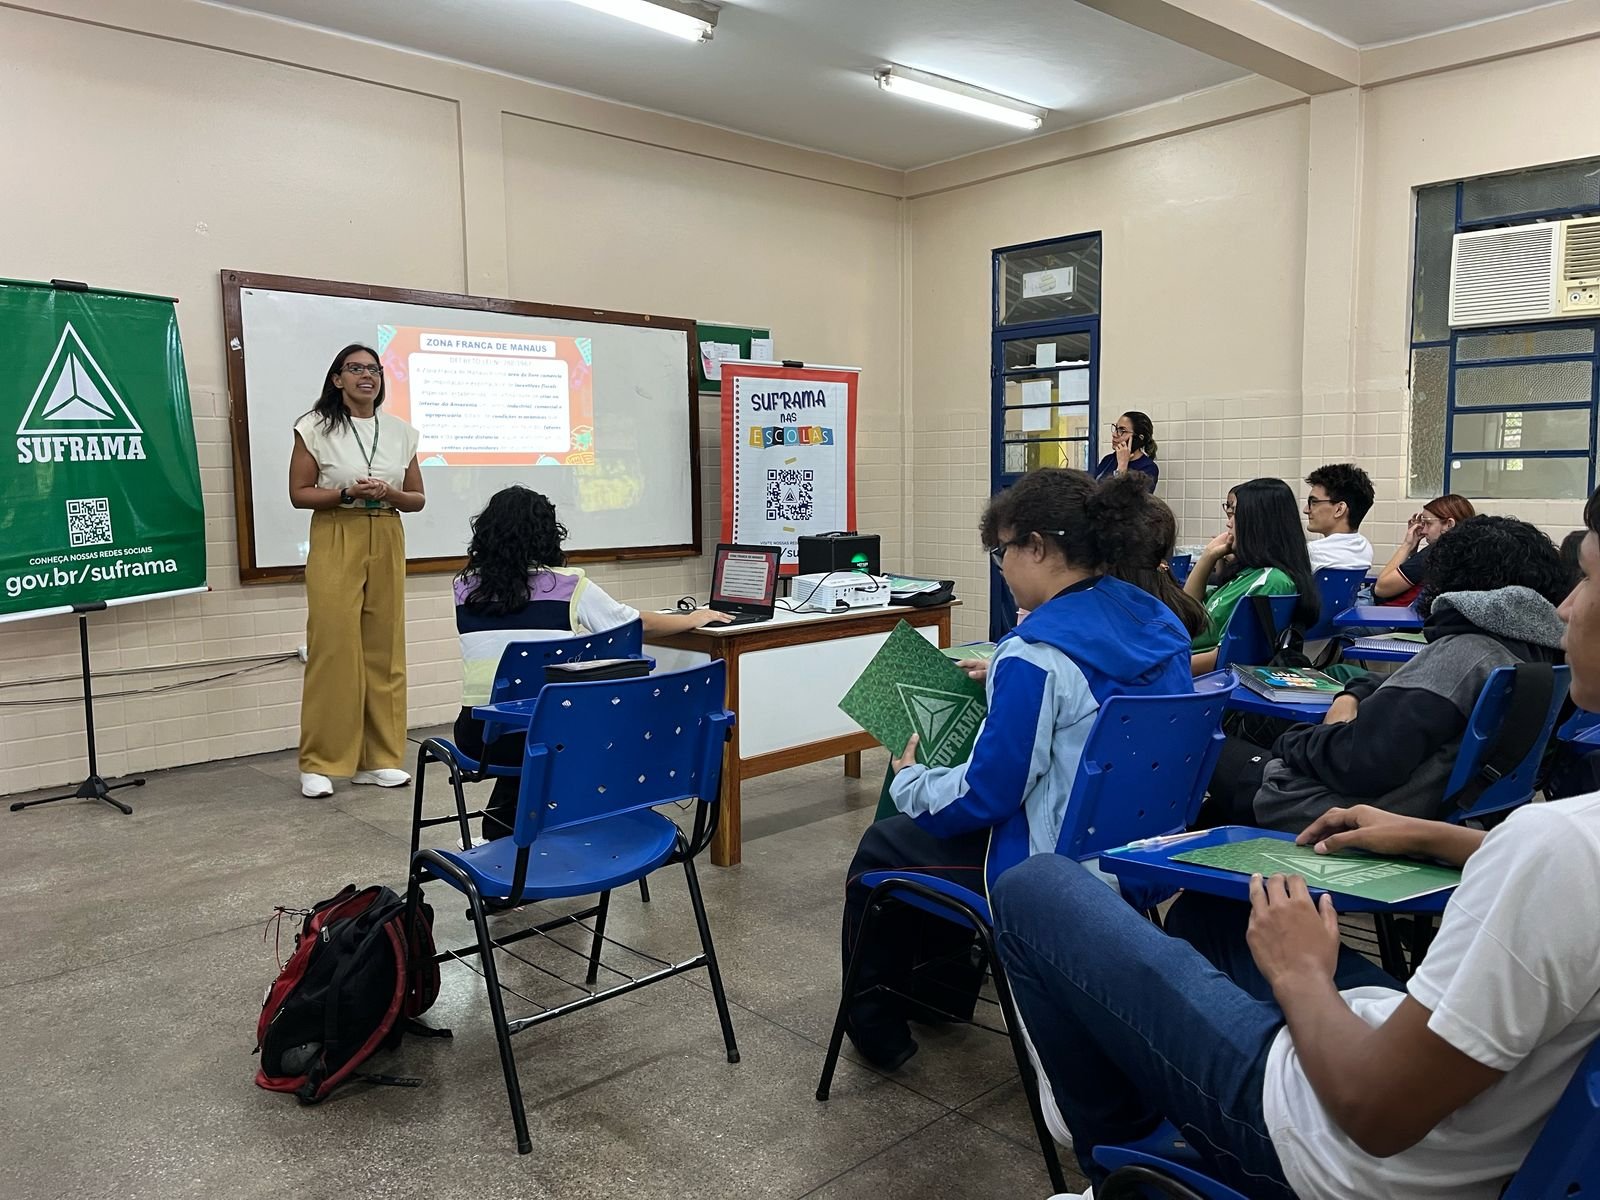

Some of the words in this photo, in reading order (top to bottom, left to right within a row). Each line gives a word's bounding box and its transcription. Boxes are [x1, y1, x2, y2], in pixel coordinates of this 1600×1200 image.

[427, 338, 453, 347] ZONA
[456, 340, 493, 350] FRANCA
[510, 344, 547, 353] MANAUS
[751, 390, 826, 411] SUFRAMA
[753, 429, 829, 445] ESCOLAS
[16, 435, 146, 464] SUFRAMA
[29, 557, 69, 567] CONHEÇA
[70, 552, 98, 561] NOSSAS
[99, 549, 123, 558] REDES
[124, 546, 153, 555] SOCIAIS
[5, 559, 178, 597] gov.br/suframa
[1325, 863, 1421, 887] SUFRAMA
